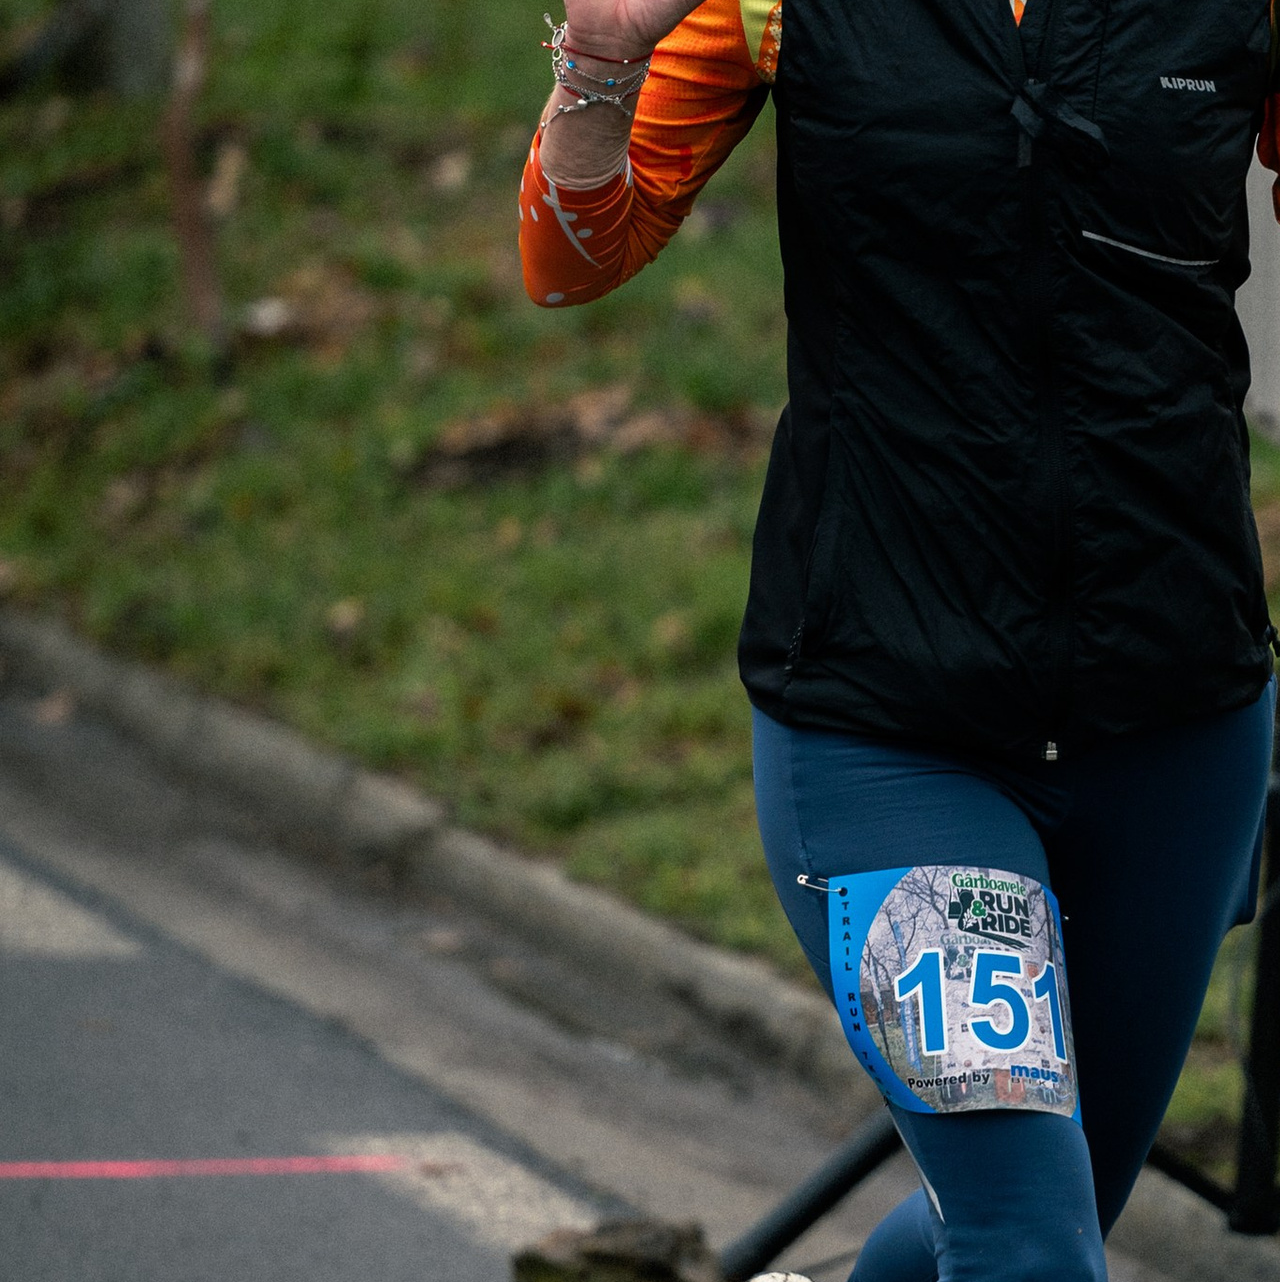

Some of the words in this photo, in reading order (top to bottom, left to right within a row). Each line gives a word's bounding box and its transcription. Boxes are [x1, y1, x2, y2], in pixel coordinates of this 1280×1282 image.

[1160, 76, 1217, 93] KIPRUN
[952, 873, 1027, 896] Gârboavele
[979, 890, 1030, 919] RUN
[971, 900, 988, 918] &
[981, 912, 1032, 938] RIDE
[841, 901, 853, 972] TRAIL
[848, 992, 862, 1032] RUN
[896, 949, 1067, 1063] 151
[908, 1072, 967, 1089] Powered
[972, 1069, 991, 1085] by
[1010, 1064, 1058, 1083] maus
